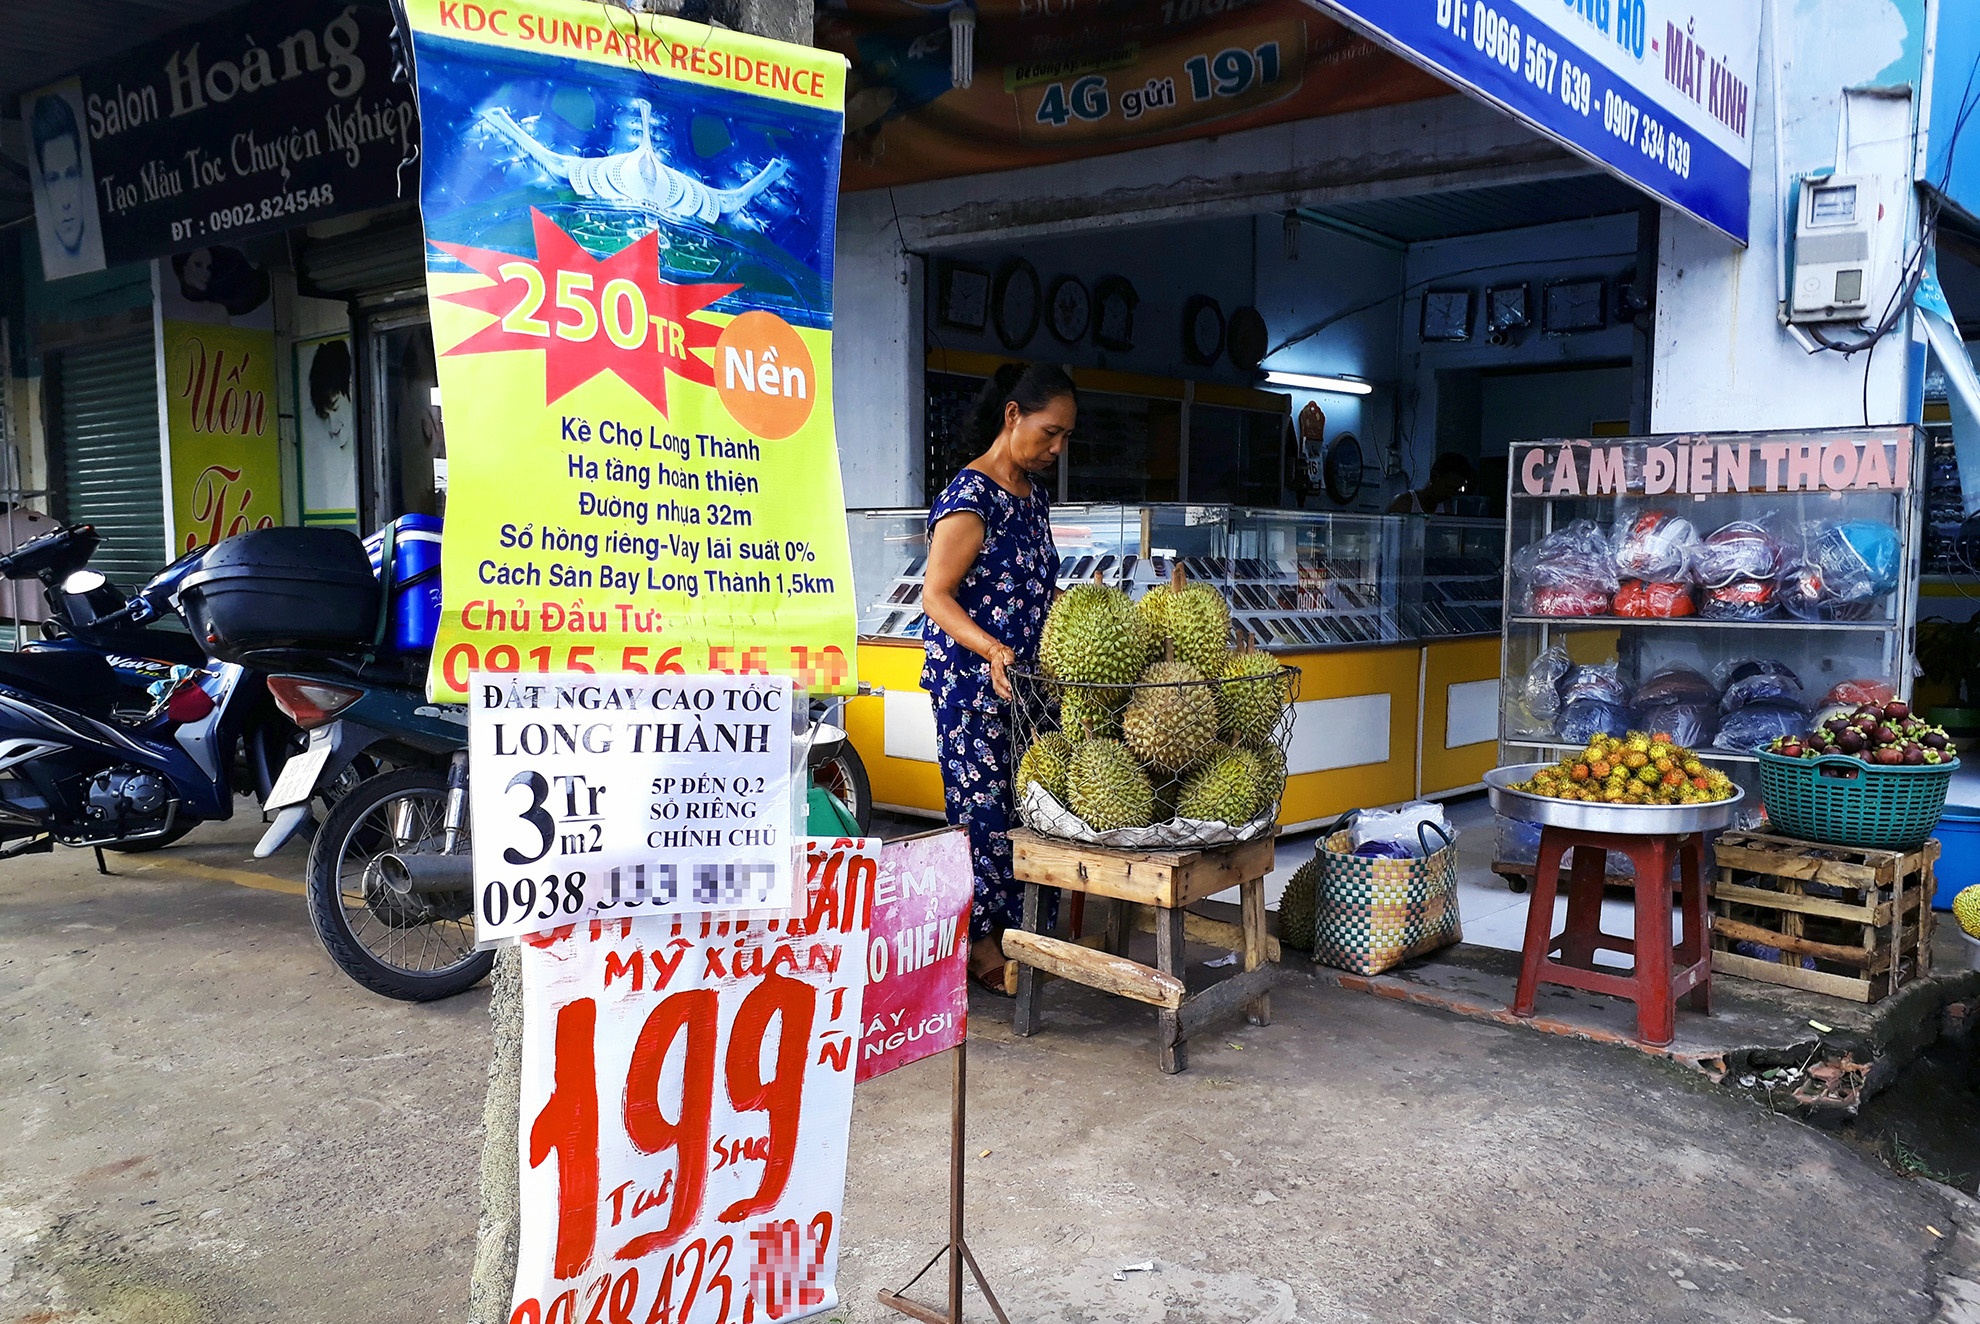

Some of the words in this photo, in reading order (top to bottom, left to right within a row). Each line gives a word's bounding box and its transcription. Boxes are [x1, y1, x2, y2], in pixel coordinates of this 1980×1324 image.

[86, 83, 160, 140] Salon
[163, 5, 367, 118] Hoàng
[439, 2, 513, 32] KDC
[518, 15, 661, 67] SUNPARK
[670, 42, 826, 99] RESIDENCE
[1036, 74, 1111, 126] 4G
[1120, 76, 1176, 121] gửi
[1184, 40, 1280, 101] 191
[1472, 0, 1521, 74] 0966
[1524, 34, 1558, 95] 567
[1561, 60, 1591, 118] 639
[1604, 88, 1639, 147] 0907
[1640, 113, 1665, 165] 334
[1667, 131, 1691, 180] 639
[1664, 15, 1706, 106] MẮT
[1708, 54, 1749, 139] KÍNH
[101, 174, 138, 216] Tạo
[184, 146, 227, 190] Tóc
[231, 125, 322, 194] Chuyên
[324, 97, 413, 169] Nghiệp
[210, 182, 335, 233] 0902.824548
[724, 345, 808, 400] Nền
[599, 420, 643, 449] Chợ
[649, 426, 691, 460] Long
[695, 434, 761, 462] Thành
[567, 454, 599, 482] Hạ
[604, 458, 651, 491] tầng
[658, 462, 701, 491] hoàn
[705, 469, 760, 496] thiện
[579, 491, 649, 526] Đường
[656, 498, 701, 527] nhựa
[706, 503, 753, 527] 32m
[499, 522, 534, 549] Sổ
[541, 525, 599, 558] hồng
[707, 537, 733, 559] lãi
[739, 536, 781, 562] suất
[785, 540, 816, 563] 0%
[478, 559, 541, 587] Cách
[548, 563, 593, 588] Sân
[600, 565, 640, 595] Bay
[647, 567, 700, 597] Long
[704, 569, 771, 594] Thành
[776, 573, 836, 598] 1,5km
[460, 598, 531, 632] Chủ
[539, 597, 607, 634] Đầu
[614, 604, 664, 634] Tư:
[105, 654, 170, 671] Wave
[483, 677, 547, 709] ĐẤT
[554, 686, 647, 711] NGAY
[651, 688, 715, 712] CAO
[723, 683, 783, 712] TỐC
[492, 722, 614, 756] LONG
[626, 713, 772, 754] THÀNH
[651, 777, 677, 795] 5P
[680, 772, 727, 794] ĐẾN
[733, 776, 765, 797] Q.2
[685, 796, 757, 819] RIÊNG
[502, 770, 556, 865] 3
[553, 775, 606, 817] Tr
[559, 825, 605, 855] m2
[647, 824, 722, 848] CHÍNH
[728, 824, 777, 847] CHỦ
[482, 871, 588, 928] 0938
[896, 897, 959, 977] HIỂM
[864, 1011, 953, 1061] NGƯỜI
[529, 972, 819, 1281] 199
